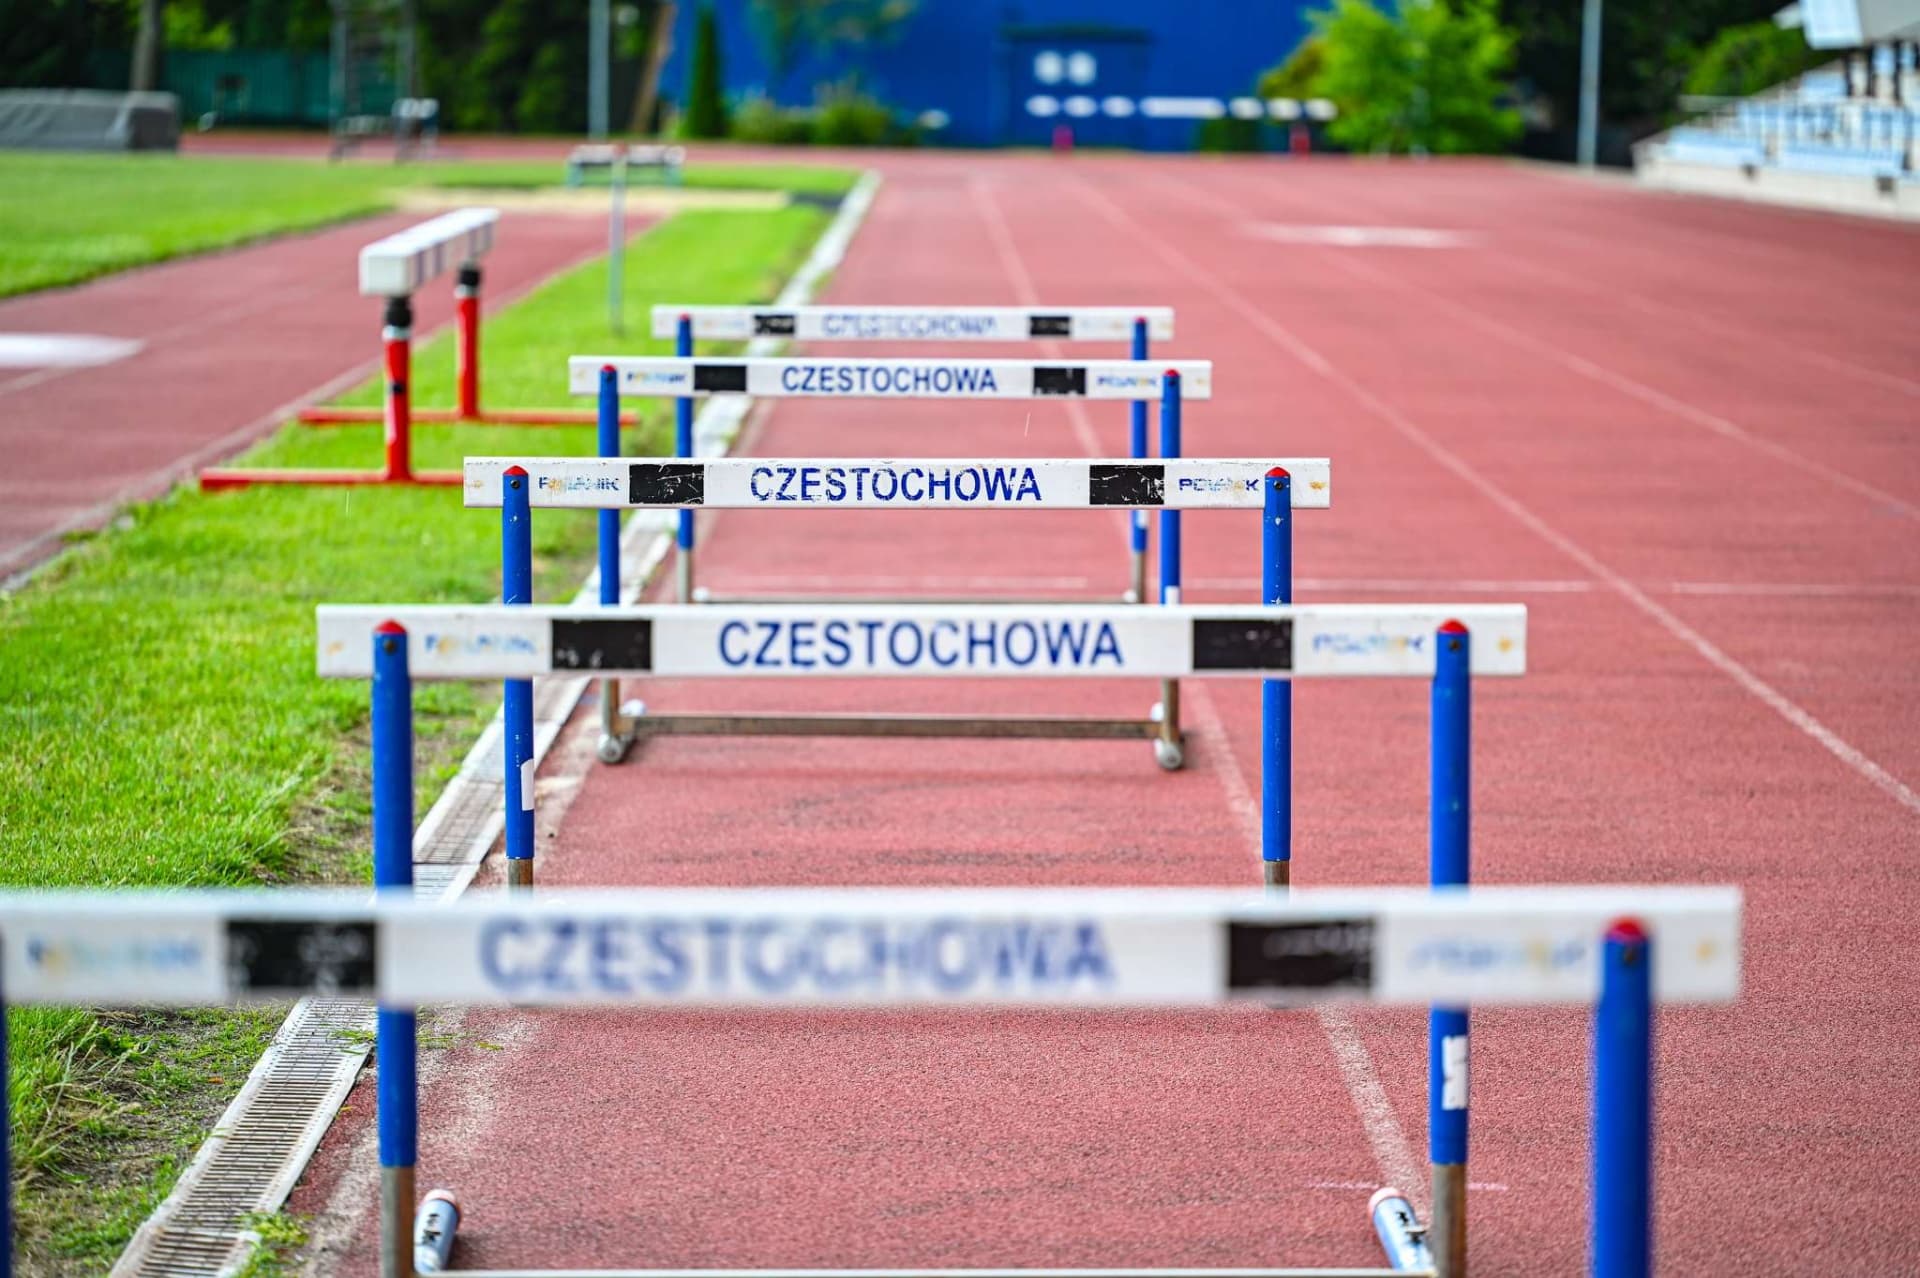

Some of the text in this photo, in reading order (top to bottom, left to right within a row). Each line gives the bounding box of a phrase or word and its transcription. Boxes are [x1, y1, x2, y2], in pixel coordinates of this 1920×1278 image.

[781, 365, 998, 393] CZESTOCHOWA
[750, 466, 1041, 502] CZESTOCHOWA
[718, 620, 1122, 668] CZESTOCHOWA
[479, 914, 1115, 995] CZESTOCHOWA
